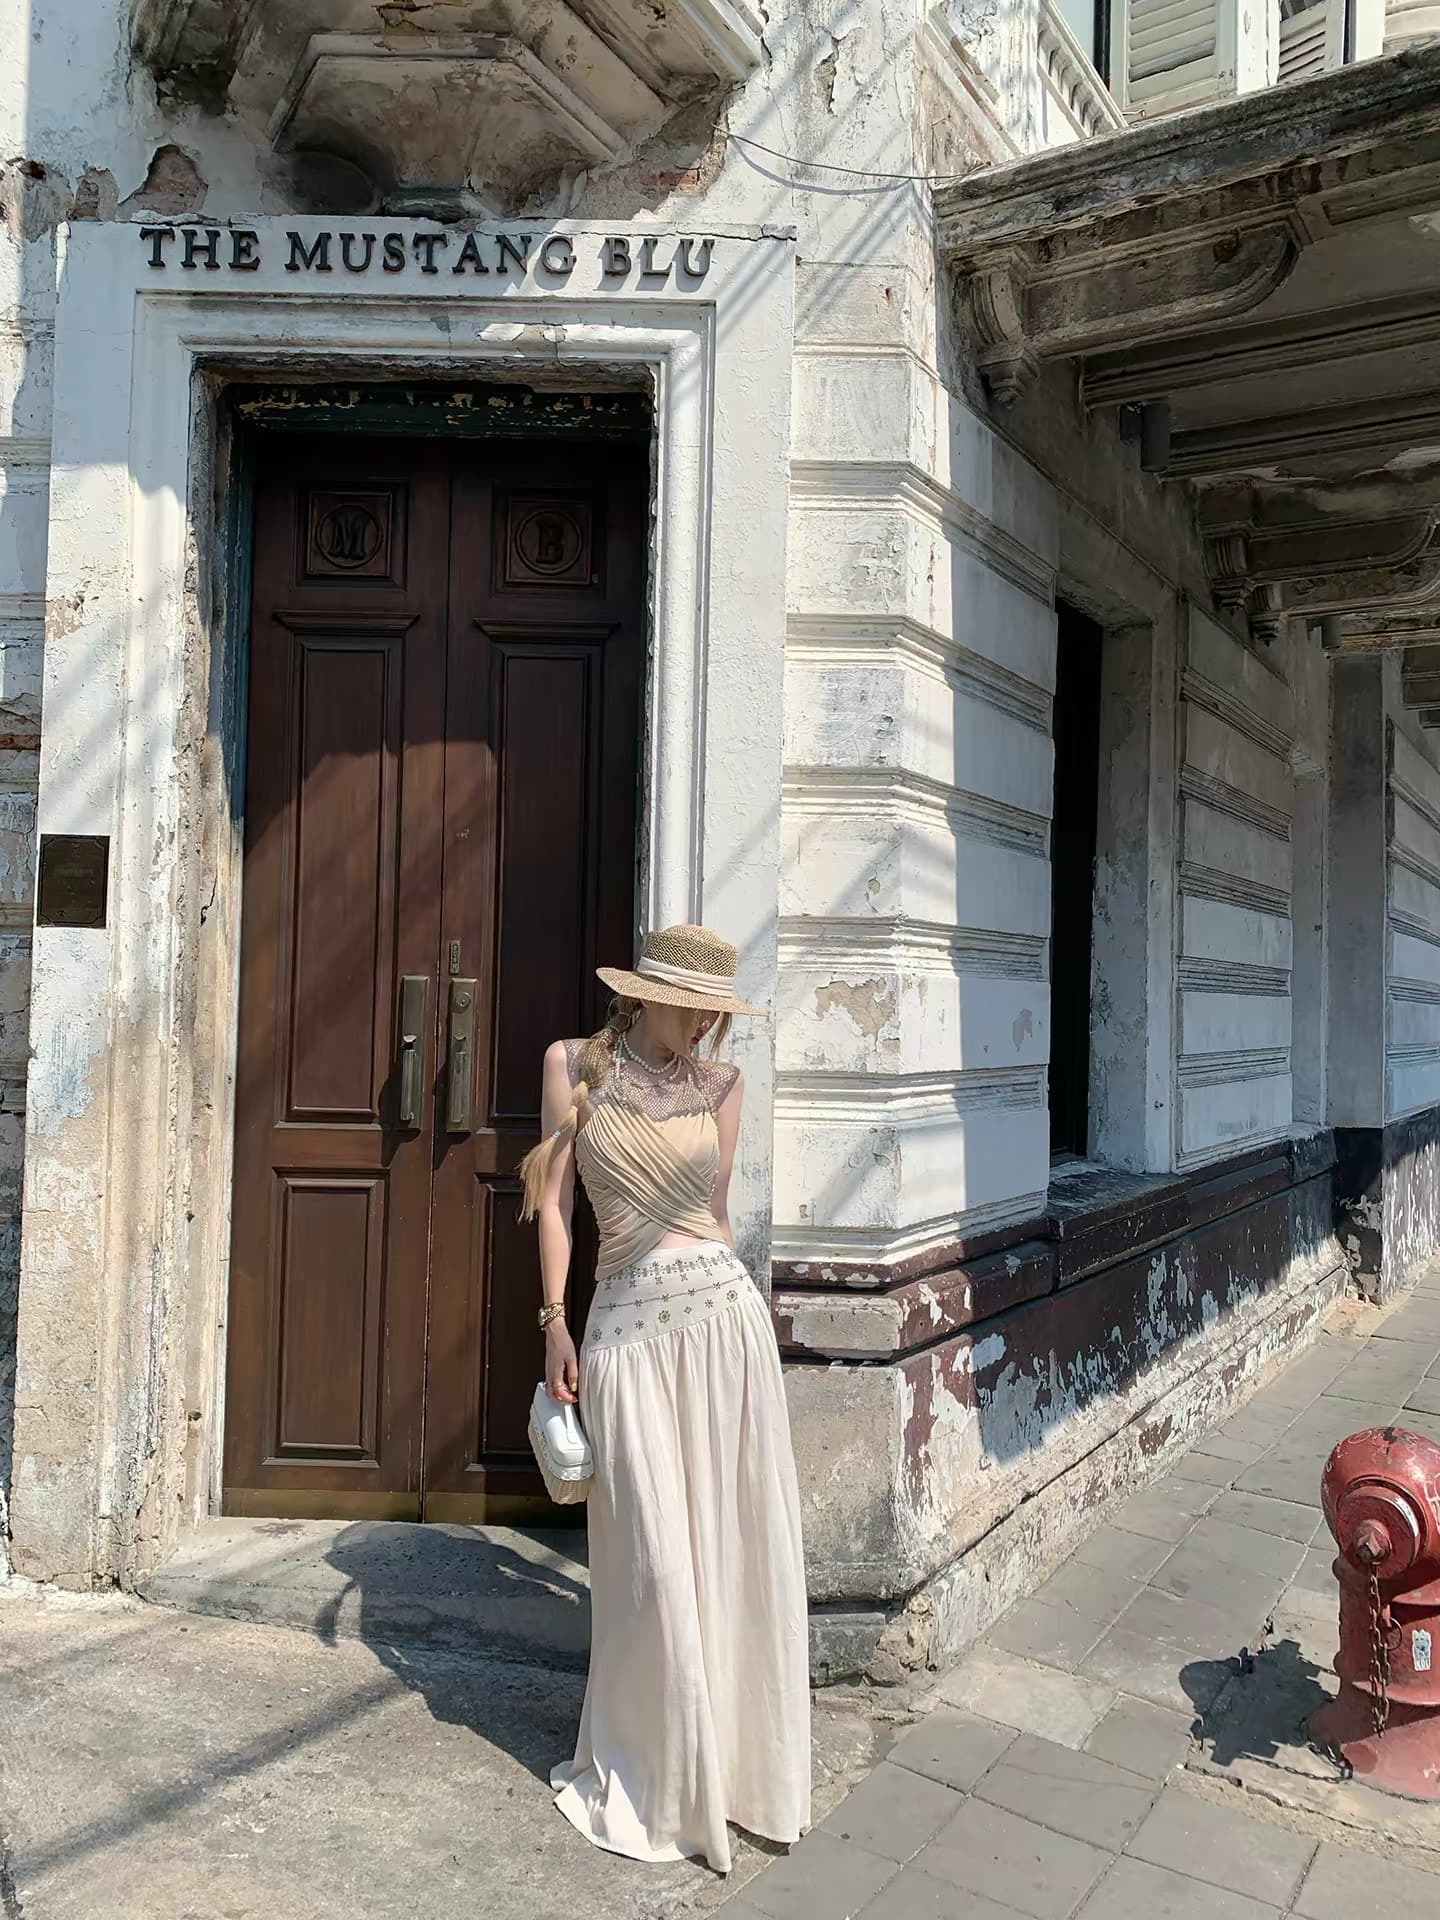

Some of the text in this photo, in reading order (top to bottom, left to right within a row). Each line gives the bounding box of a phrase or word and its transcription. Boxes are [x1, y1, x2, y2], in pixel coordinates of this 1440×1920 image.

[139, 226, 714, 277] THE MUSTANG BLU
[329, 510, 369, 560] M
